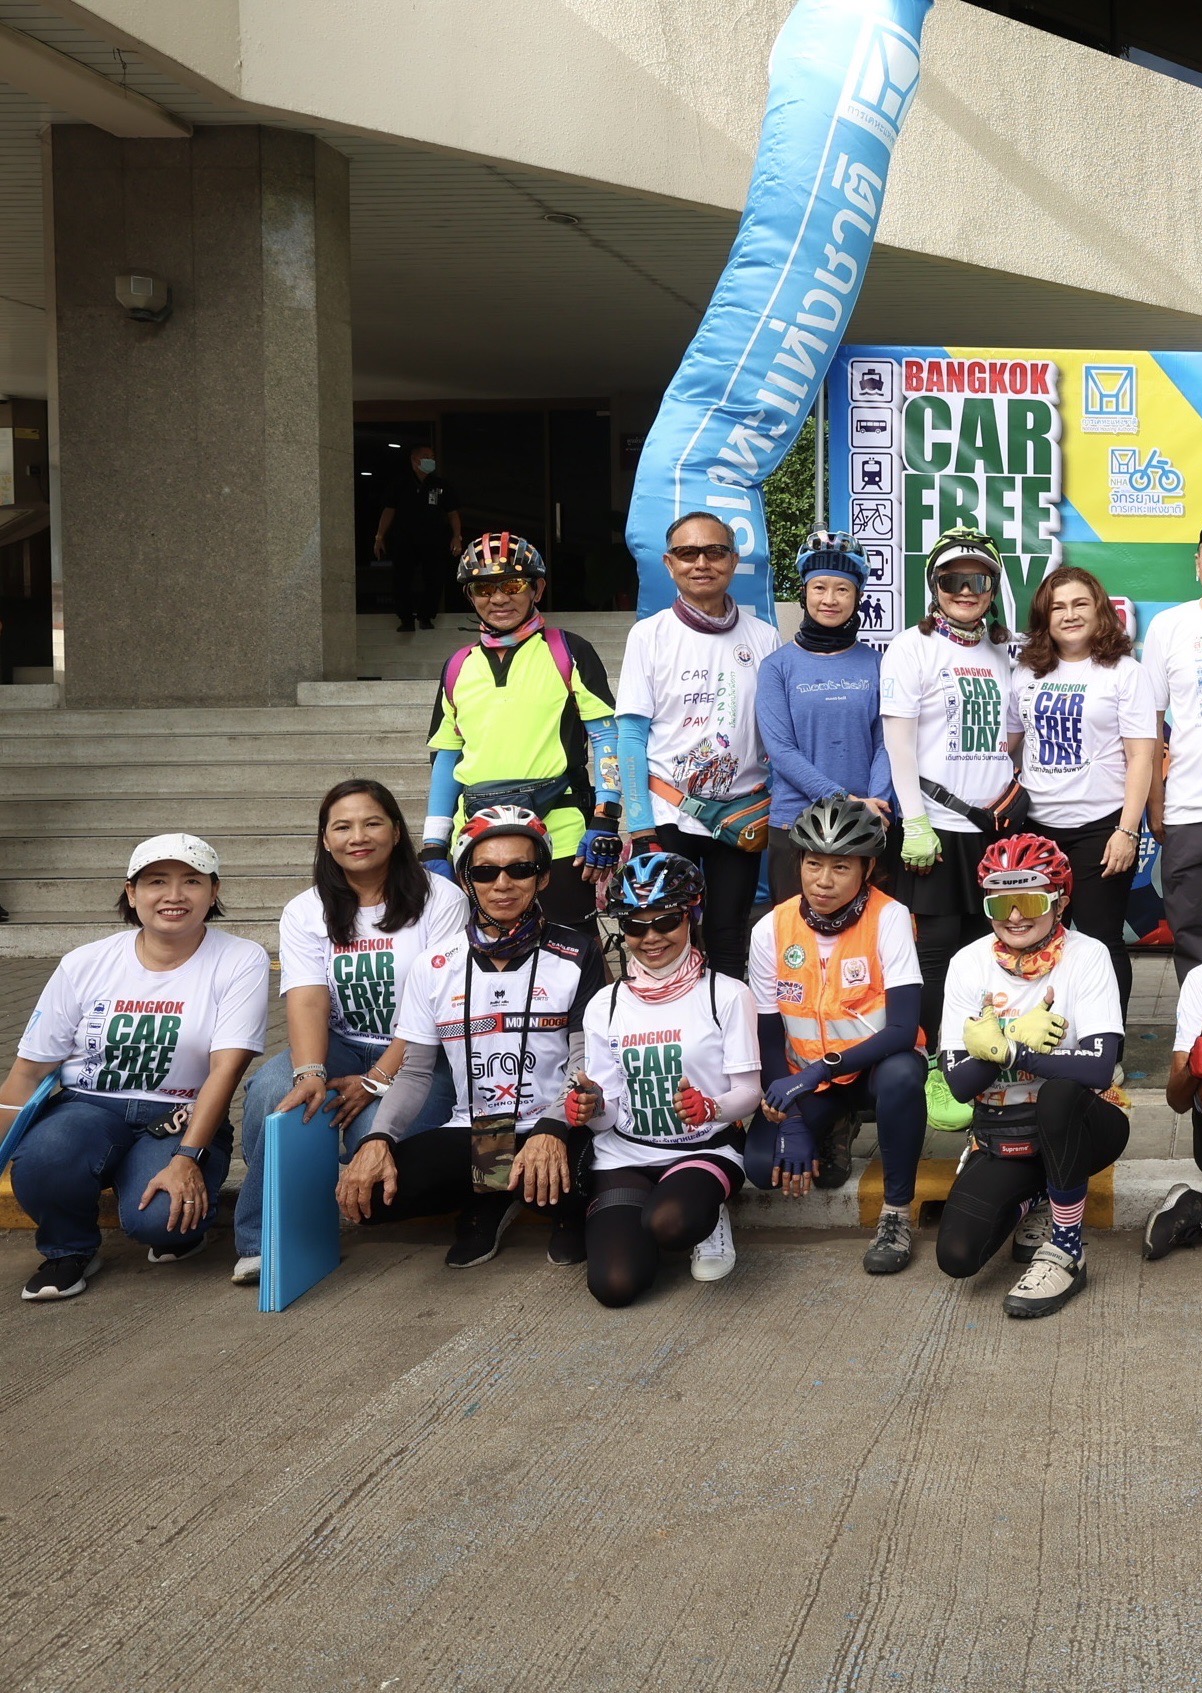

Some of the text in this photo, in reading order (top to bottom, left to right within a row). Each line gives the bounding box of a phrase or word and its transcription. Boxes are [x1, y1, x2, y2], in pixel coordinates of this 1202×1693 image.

[905, 360, 1050, 395] BANGKOK
[904, 396, 1052, 475] CAR
[904, 475, 1052, 555] FREE
[681, 669, 709, 681] CAR
[953, 667, 994, 678] BANGKOK
[683, 693, 715, 705] FREE
[958, 677, 1002, 701] CAR
[1040, 682, 1088, 693] BANGKOK
[962, 699, 1002, 727] FREE
[1034, 691, 1085, 718] CAR
[682, 716, 709, 728] DAY
[1034, 714, 1083, 744] FREE
[961, 726, 1000, 753] DAY
[1039, 739, 1082, 766] DAY
[1002, 878, 1029, 886] SUPER
[333, 951, 395, 985] CAR
[114, 1000, 185, 1014] BANGKOK
[336, 980, 397, 1012] FREE
[106, 1013, 182, 1046] CAR
[343, 1008, 396, 1035] DAY
[621, 1029, 682, 1048] BANGKOK
[104, 1044, 176, 1074] FREE
[622, 1044, 683, 1078] CAR
